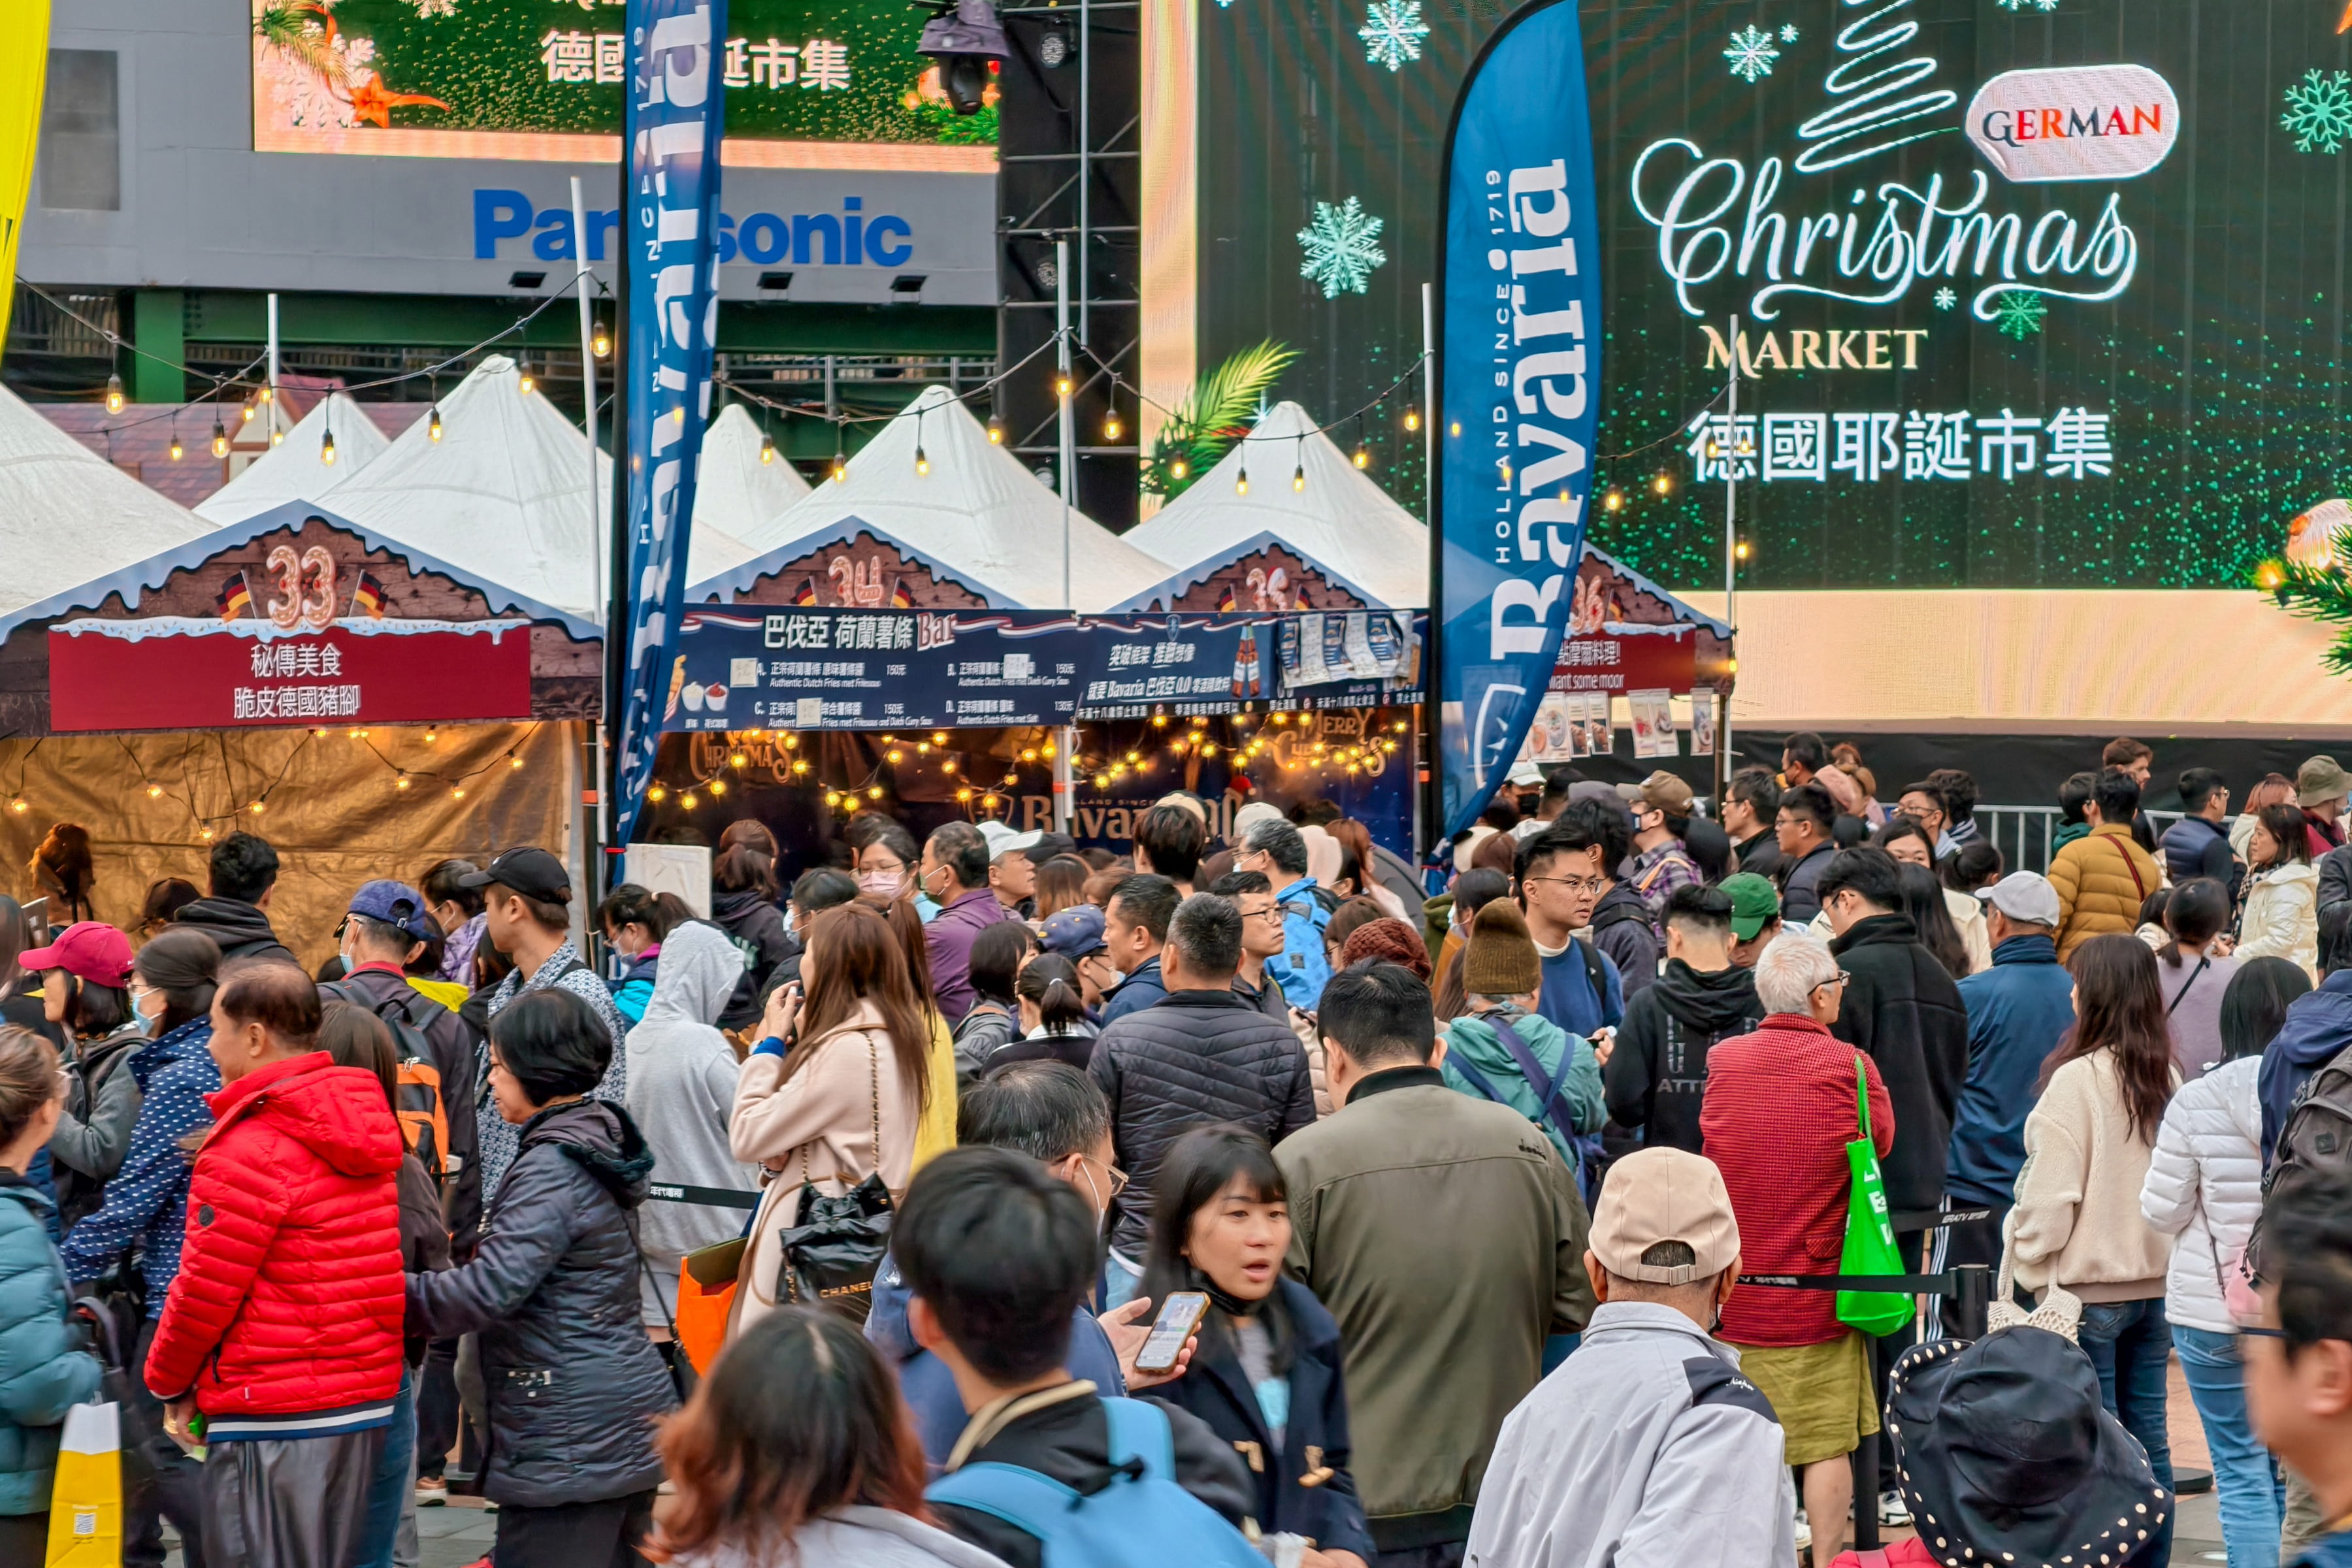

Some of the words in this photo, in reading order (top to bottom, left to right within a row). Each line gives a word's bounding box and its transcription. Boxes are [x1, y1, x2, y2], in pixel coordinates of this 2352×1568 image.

[541, 30, 851, 90] 德國市集
[1982, 103, 2163, 150] GERMAN
[472, 188, 913, 268] Panonic
[1486, 169, 1505, 236] 1719
[1631, 137, 2138, 321] Christmas
[1494, 283, 1511, 388] SINCE
[1699, 325, 1929, 379] MARKET
[1488, 157, 1588, 661] Bavaria
[1687, 407, 2114, 483] 德國耶誕市集
[1493, 405, 1511, 564] HOLLAND
[266, 544, 336, 630] 33
[764, 614, 831, 649] 巴伐亞
[835, 613, 914, 649] 荷蘭薯條
[917, 612, 958, 651] Bar
[250, 642, 343, 678] 秘傳美食
[770, 678, 803, 687] Authentic
[803, 678, 823, 687] Dutch
[824, 678, 841, 687] Fries
[1573, 674, 1599, 689] some
[234, 684, 362, 719] 脆皮德國豬腳
[1107, 679, 1145, 698] Bavaria
[768, 718, 796, 728] Authent
[690, 730, 791, 783] CHRMAS
